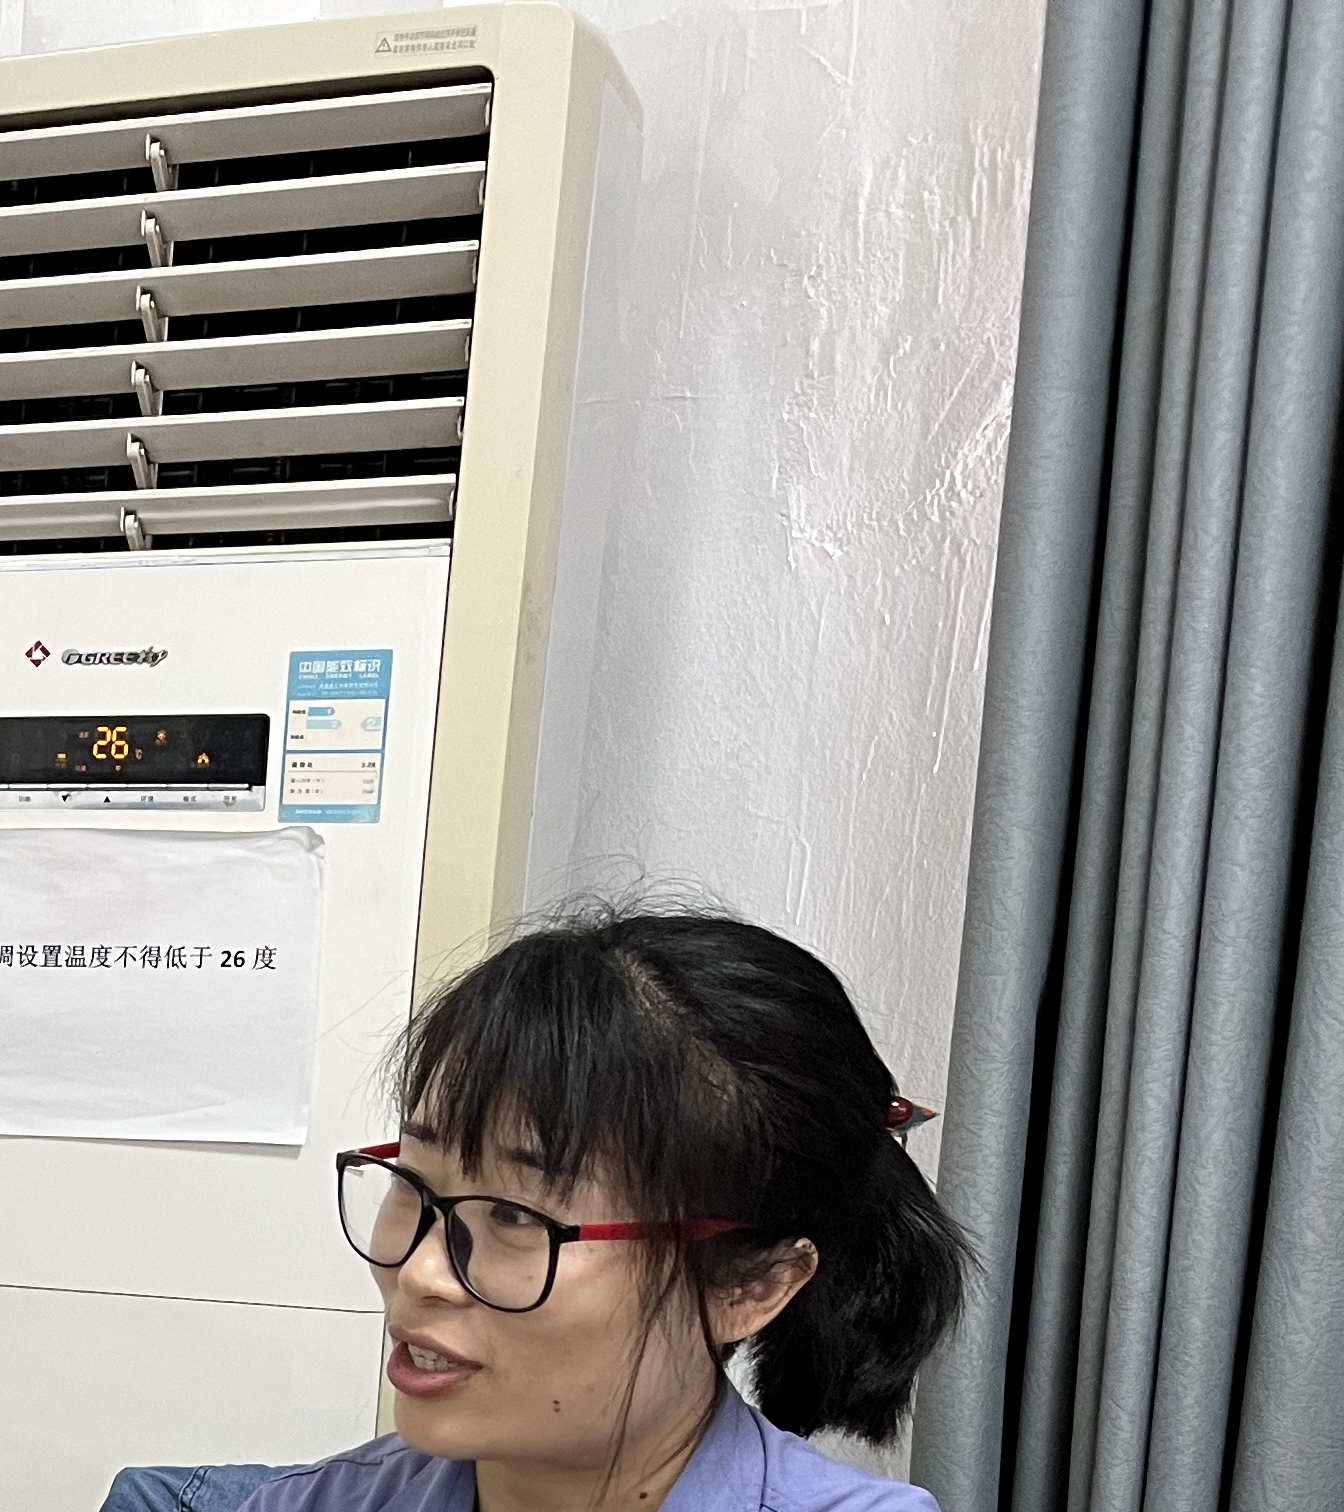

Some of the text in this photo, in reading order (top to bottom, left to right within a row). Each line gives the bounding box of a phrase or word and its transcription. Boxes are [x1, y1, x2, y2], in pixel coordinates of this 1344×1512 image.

[298, 658, 381, 674] 中国能效标识
[92, 725, 129, 760] 26
[219, 951, 246, 969] 26
[252, 945, 278, 972] 度
